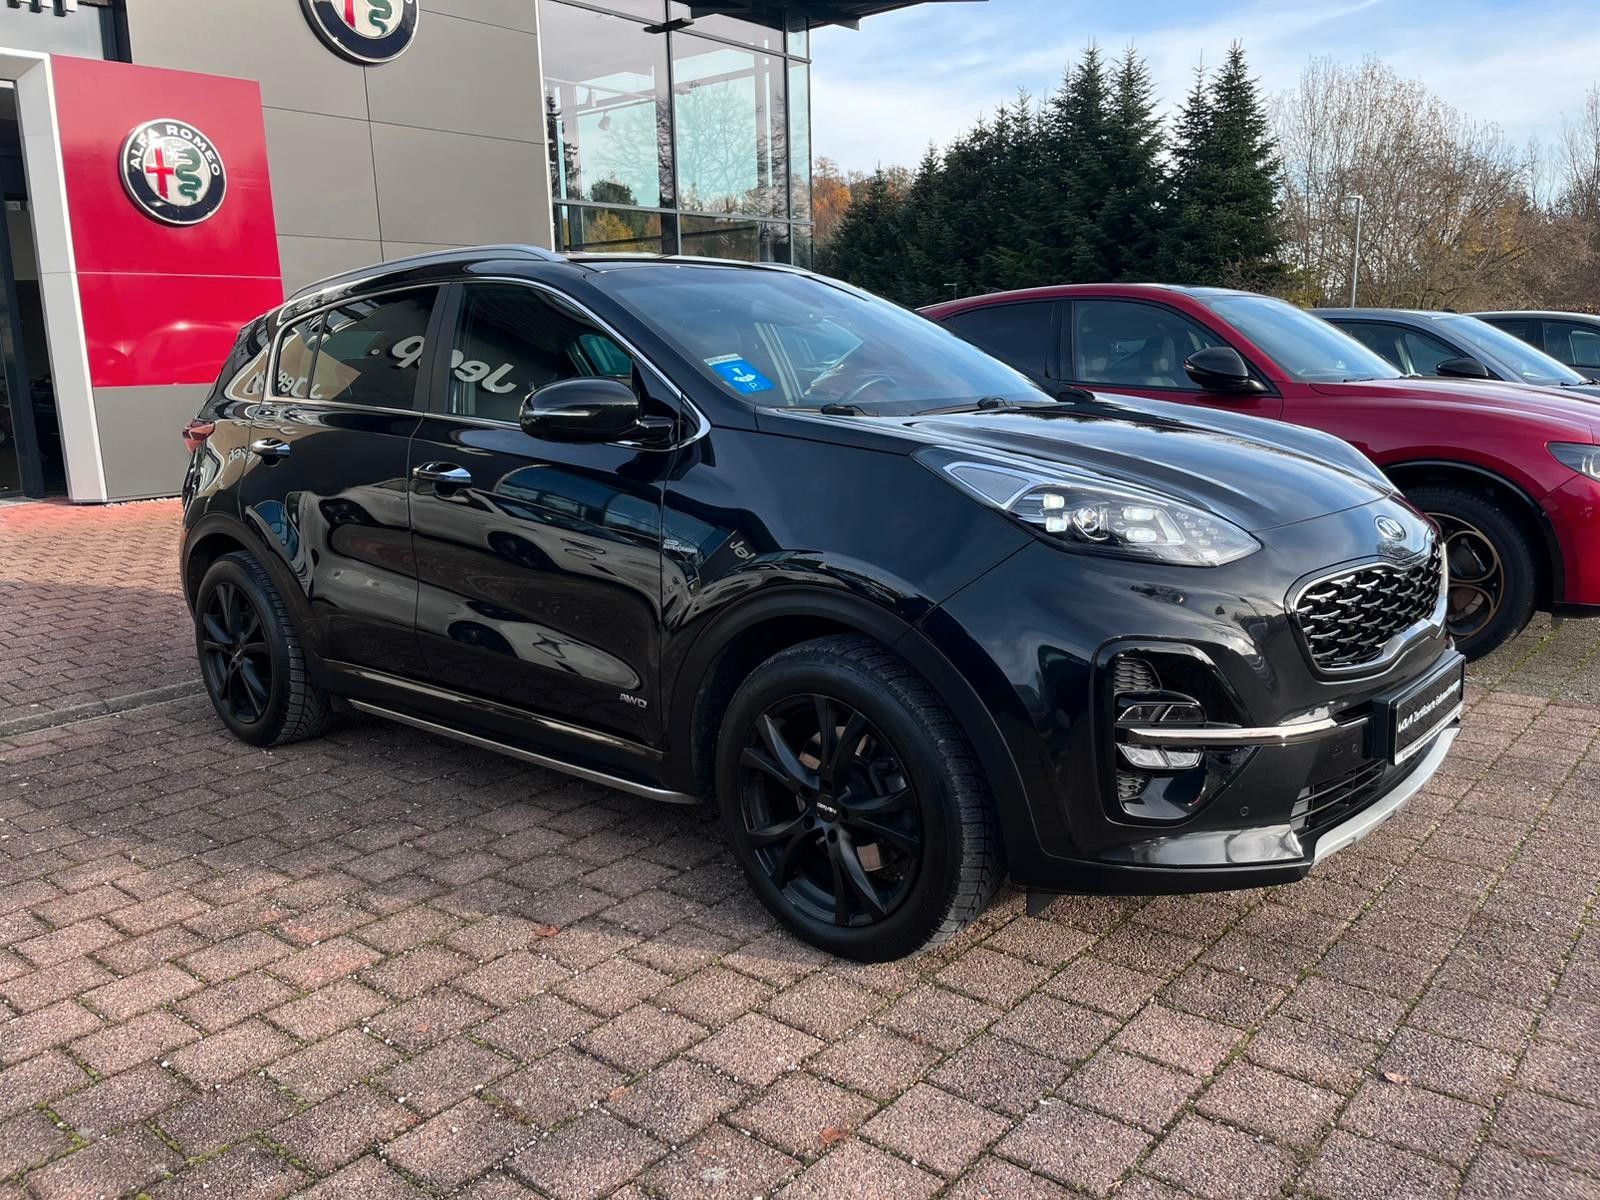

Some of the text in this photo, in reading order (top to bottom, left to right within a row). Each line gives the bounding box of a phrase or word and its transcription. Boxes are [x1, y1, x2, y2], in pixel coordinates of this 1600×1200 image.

[130, 124, 220, 176] ALFA ROMEO
[620, 693, 647, 708] AWD
